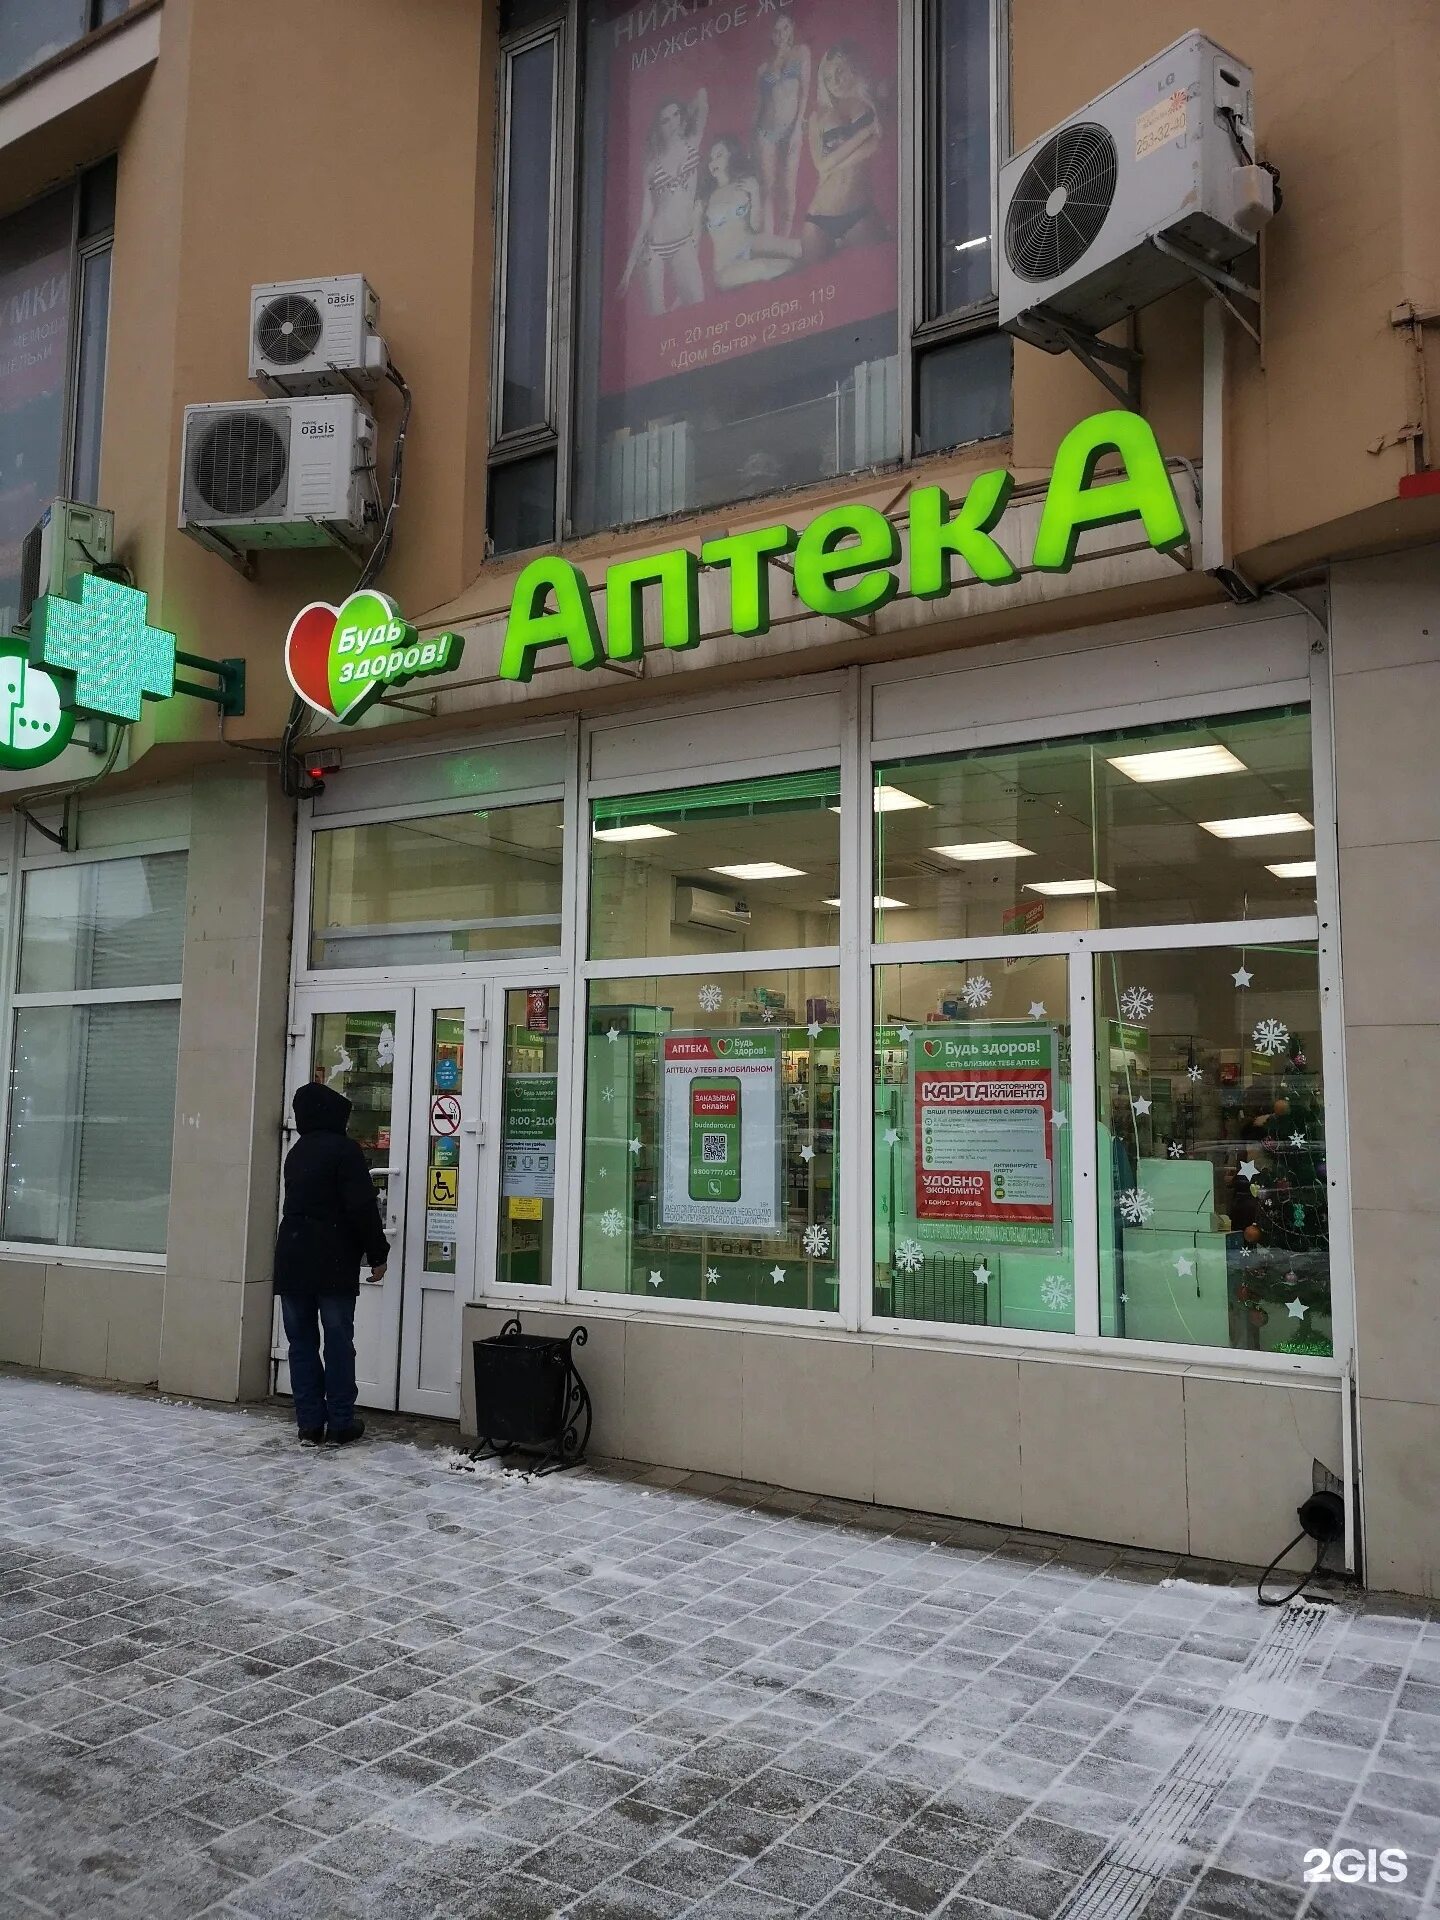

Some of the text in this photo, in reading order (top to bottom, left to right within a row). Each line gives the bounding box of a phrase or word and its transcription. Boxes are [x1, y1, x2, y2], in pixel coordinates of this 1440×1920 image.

[631, 4, 748, 71] МУЖСКОЕ
[1158, 72, 1175, 92] LG
[327, 294, 355, 304] oasis
[684, 326, 702, 344] 20
[705, 320, 731, 338] лет
[809, 285, 836, 305] 119
[762, 323, 776, 344] (2
[781, 310, 824, 335] этаж)
[301, 422, 335, 434] oasis
[337, 622, 401, 655] Будь
[338, 636, 448, 683] здоров!
[671, 1044, 709, 1054] АПТЕКА
[734, 1038, 754, 1048] Будь
[945, 1039, 1041, 1058] Будь здоров!
[734, 1047, 767, 1056] здоров!
[666, 1066, 693, 1074] АПТЕКА
[694, 1066, 699, 1074] У
[724, 1065, 773, 1073] МОБИЛЬНОМ
[963, 1060, 997, 1068] БЛИЗКИХ
[695, 1093, 736, 1102] ЗАКАЗЫВАЙ
[924, 1084, 989, 1099] КАРТА
[989, 1090, 1045, 1098] КЛИЕНТА
[947, 1108, 1002, 1116] ПРЕИМУЩЕСТВА
[922, 1175, 984, 1188] УДОБНО
